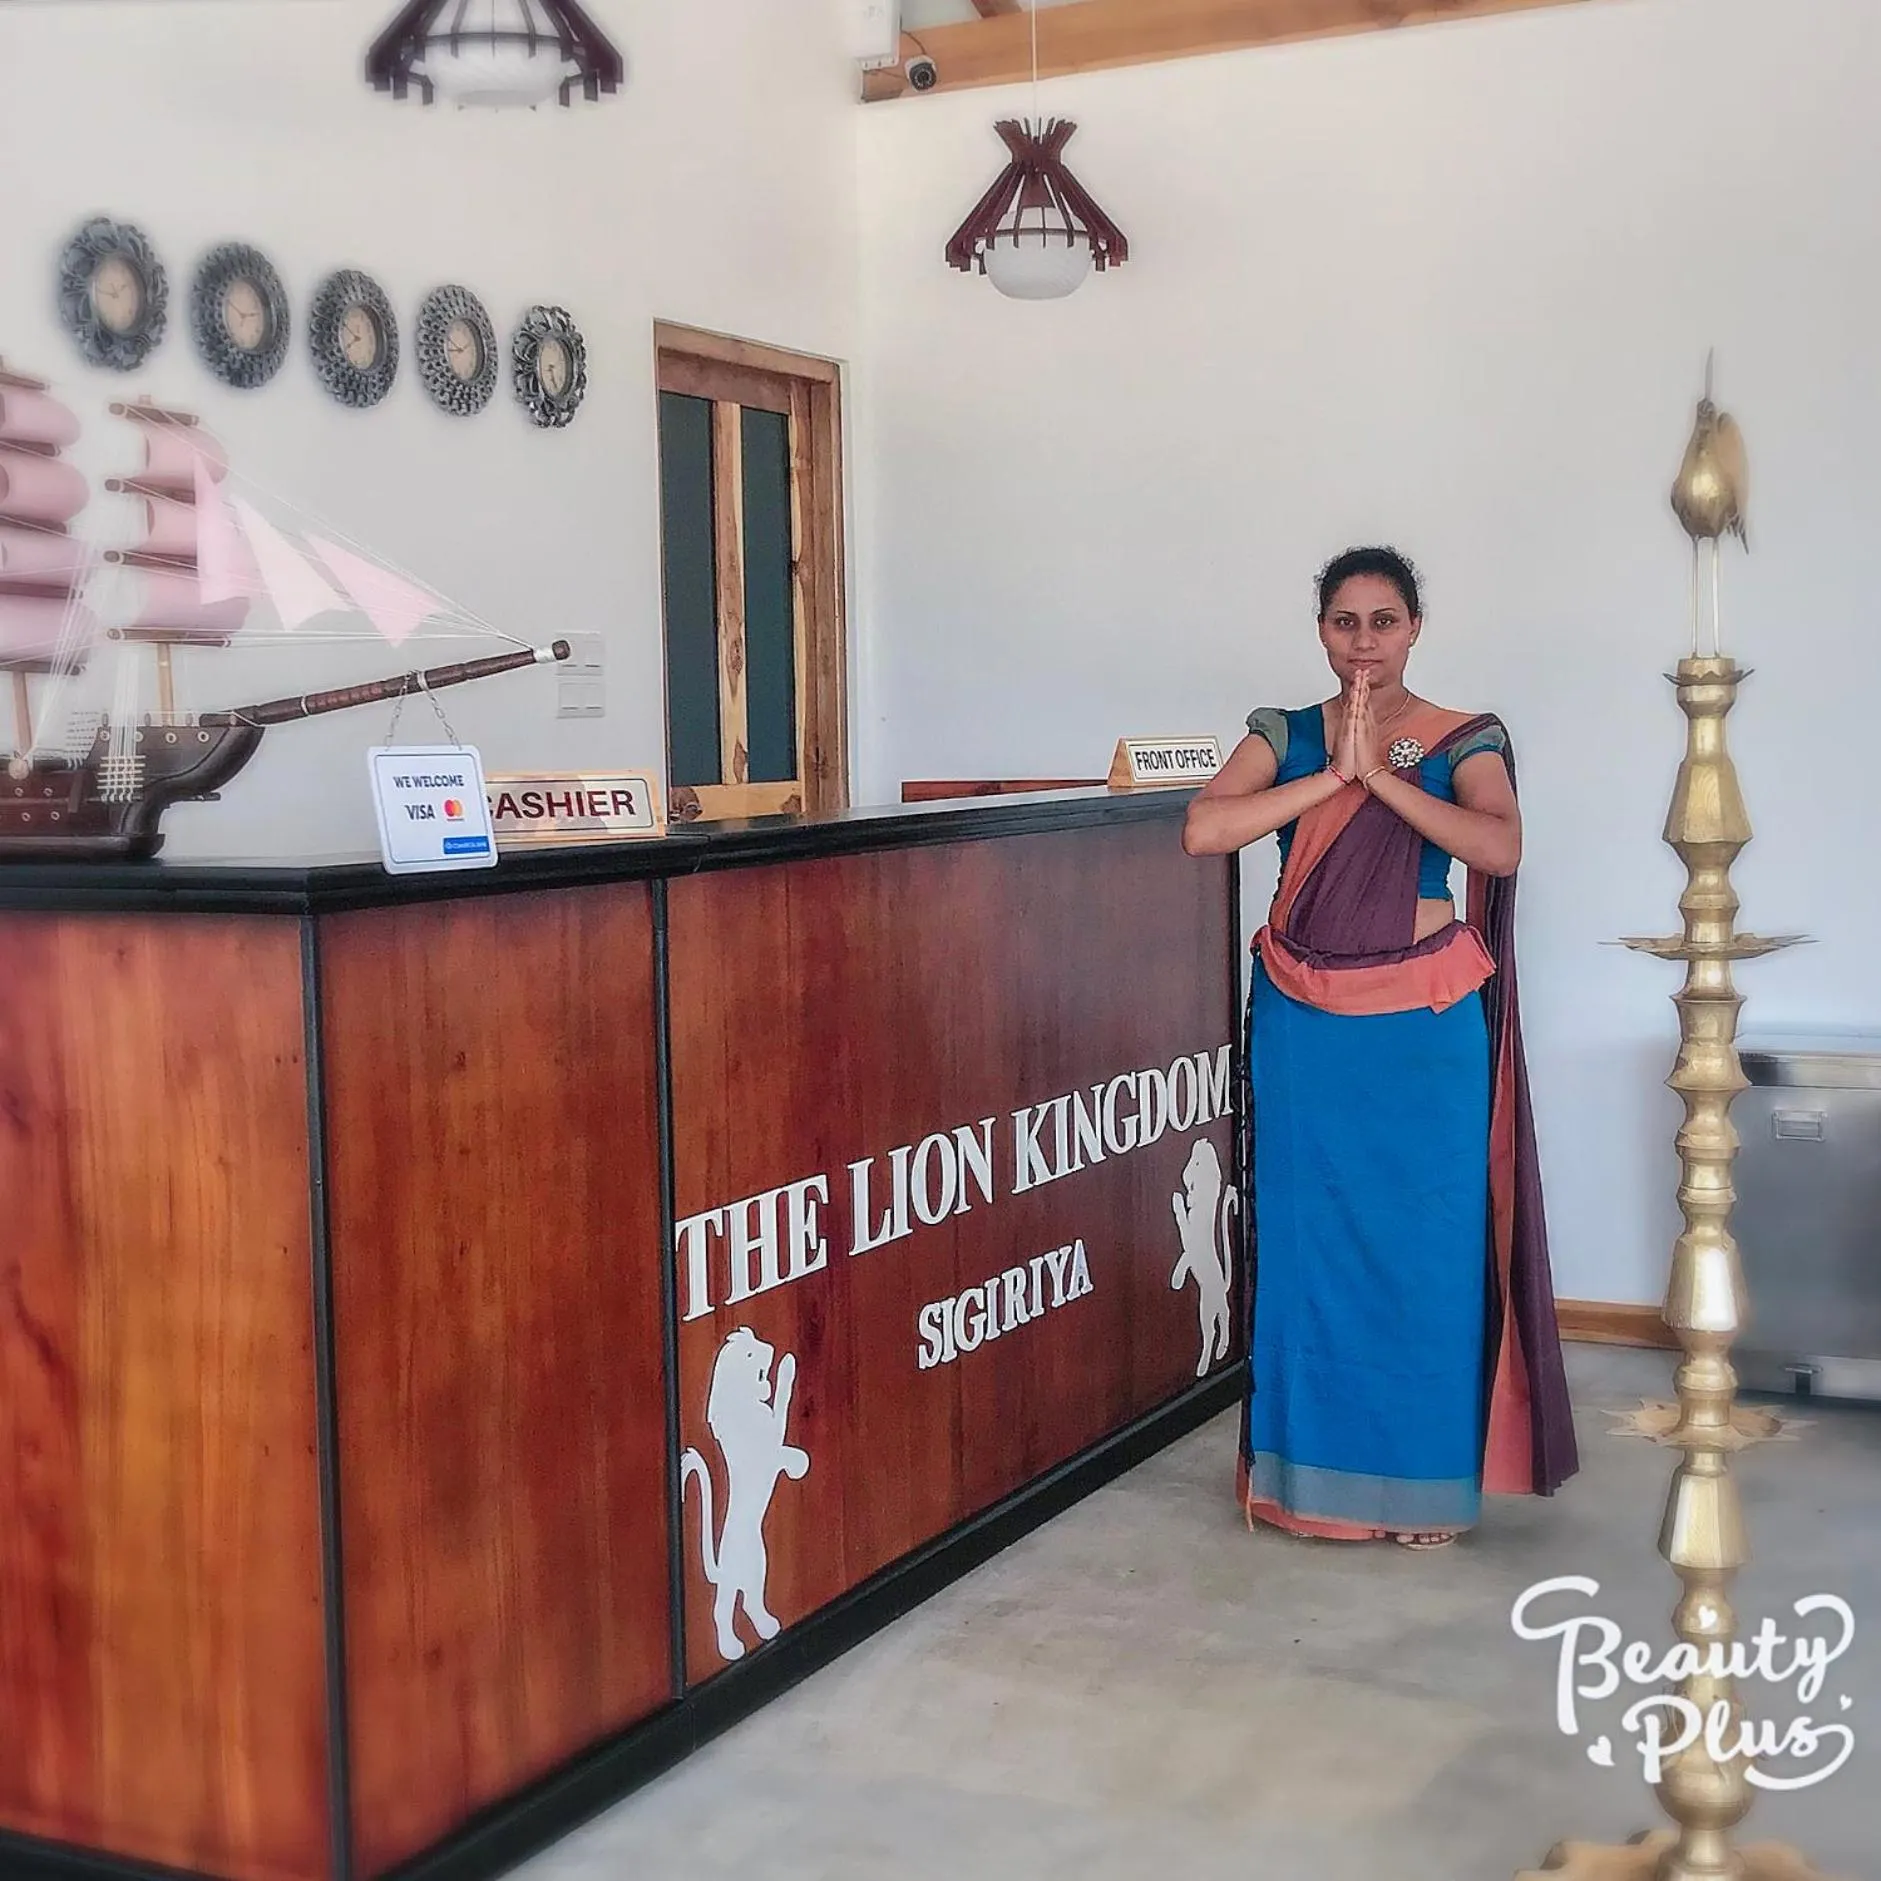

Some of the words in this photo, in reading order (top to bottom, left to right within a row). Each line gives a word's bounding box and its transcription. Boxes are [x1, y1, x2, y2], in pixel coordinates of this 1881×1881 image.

[1135, 750, 1176, 770] FRONT
[1176, 749, 1216, 769] OFFICE
[393, 775, 411, 788] WE
[412, 774, 465, 788] WELCOME
[404, 804, 436, 820] VISA
[486, 790, 636, 819] ASHIER
[675, 1174, 829, 1321] THE
[847, 1117, 996, 1256] LION
[1010, 1044, 1233, 1195] KINGDOM
[917, 1239, 1094, 1370] SIGIRIYA
